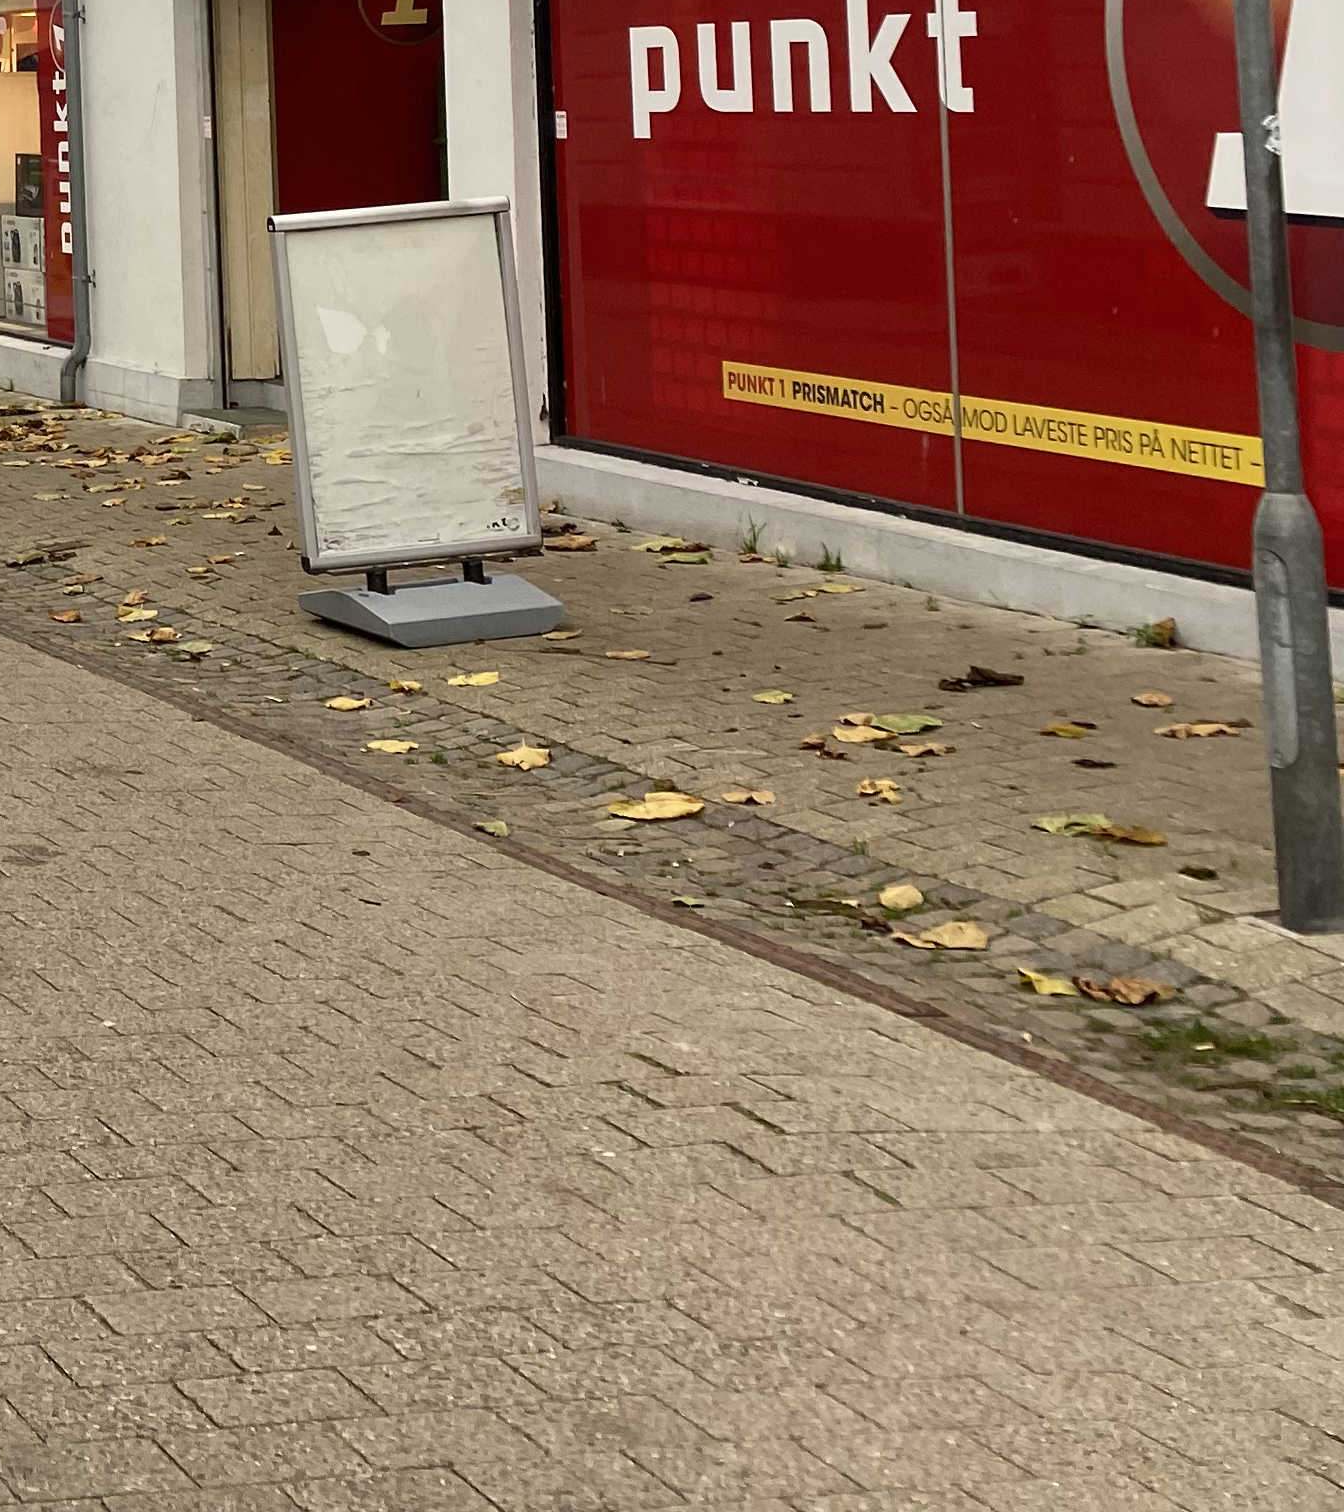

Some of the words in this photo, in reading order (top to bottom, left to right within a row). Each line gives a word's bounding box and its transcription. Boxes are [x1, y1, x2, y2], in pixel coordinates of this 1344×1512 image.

[727, 371, 775, 396] PUNKT
[778, 379, 785, 398] 1
[792, 381, 885, 414] PRISMATCH
[903, 398, 955, 428] OGSÅ
[962, 406, 1009, 434] MOD
[1013, 414, 1087, 446] LAVESTE
[1094, 425, 1133, 454] PRIS
[1140, 428, 1165, 458] PÅ
[1171, 438, 1243, 471] NETTET
